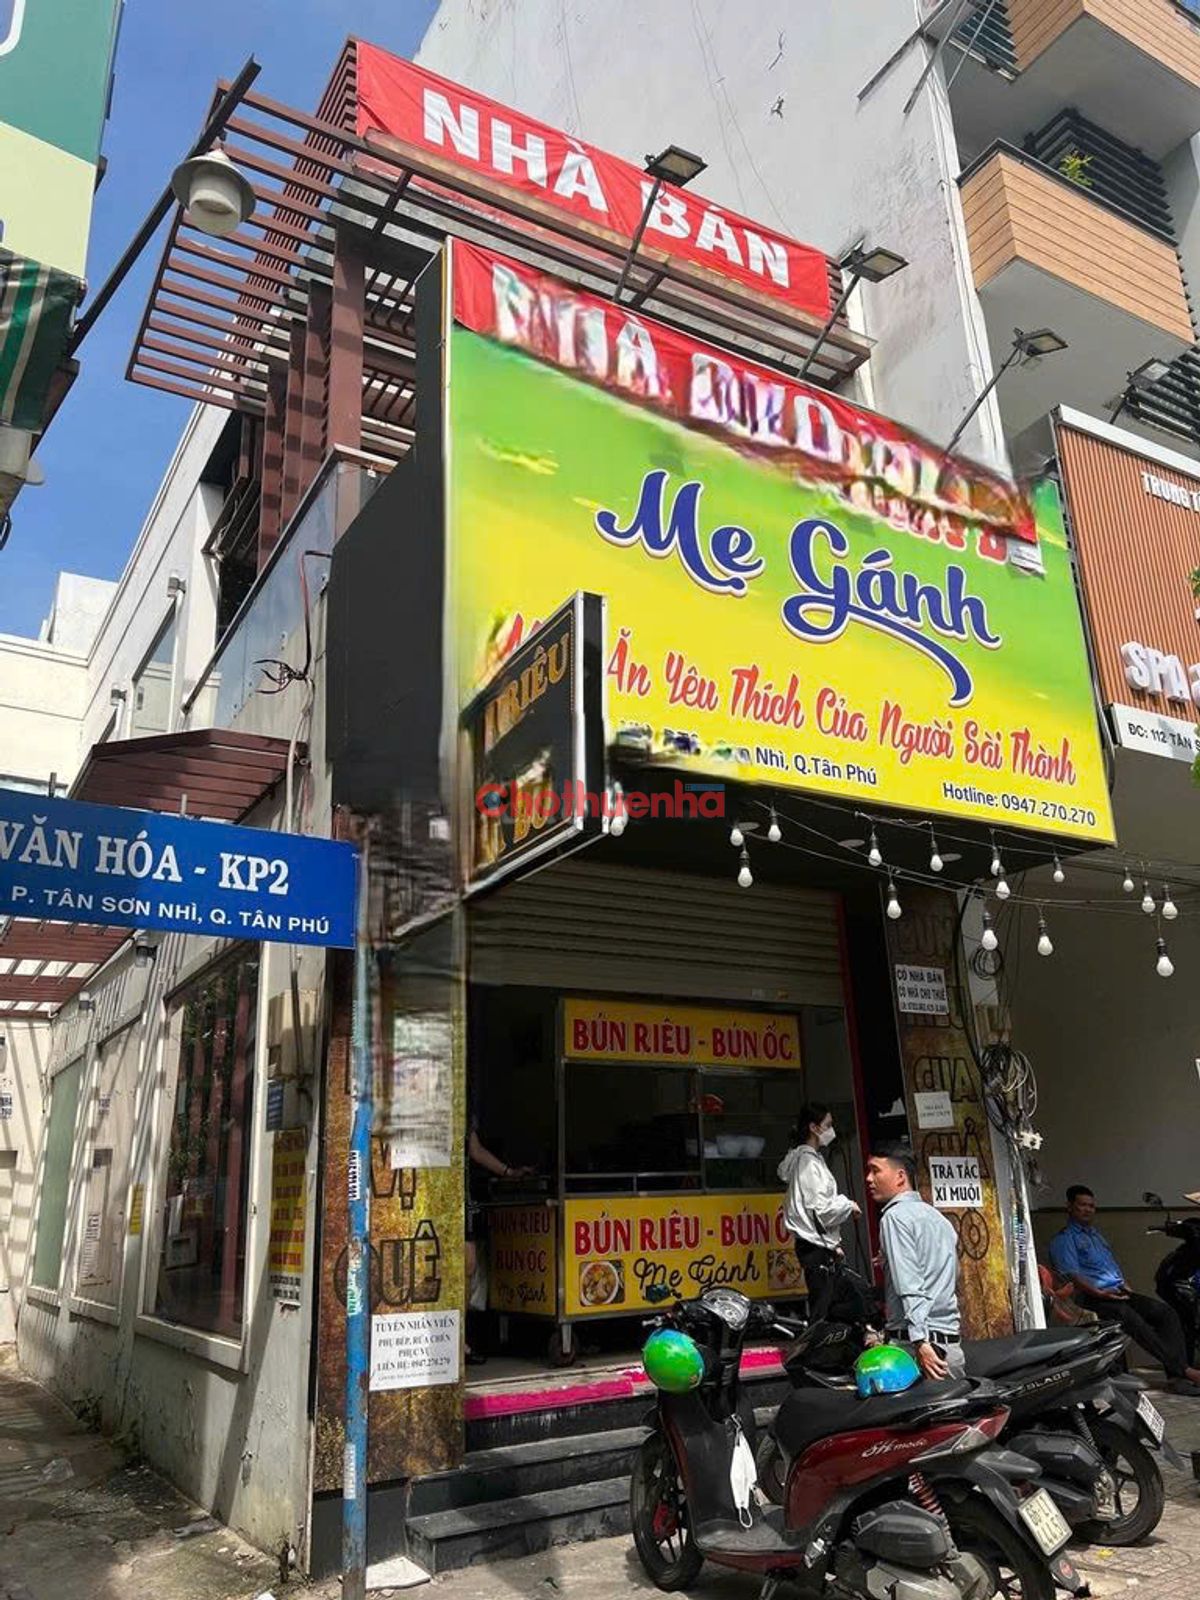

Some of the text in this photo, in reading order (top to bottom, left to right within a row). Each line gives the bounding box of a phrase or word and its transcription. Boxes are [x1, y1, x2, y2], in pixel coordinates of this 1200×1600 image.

[422, 87, 791, 289] NHÀ BÁN
[780, 518, 1001, 706] Gánh
[1120, 640, 1190, 702] SPA
[607, 627, 651, 697] Ăn
[665, 651, 719, 711] Yêu
[731, 663, 804, 729] Thích
[815, 686, 868, 742] Của
[879, 699, 954, 765] Người
[964, 719, 1003, 770] Sài
[1010, 727, 1076, 786] Thành
[1151, 729, 1167, 745] 112
[1170, 732, 1192, 750] TÂN
[755, 745, 877, 785] Nhì, Q.Tân Phú
[943, 782, 1096, 827] Hotline: 0947.270.270
[0, 814, 83, 869] VĂN
[95, 831, 182, 883] HÓA
[218, 851, 289, 896] KP2
[11, 886, 330, 934] P. TÂN SƠN NHÌ, Q. TÂN PHÚ
[573, 1012, 626, 1051] BÚN
[634, 1016, 691, 1055] RIÊU
[711, 1022, 758, 1058] BÚN
[762, 1020, 793, 1060] ỐC
[932, 1161, 954, 1179] TRÀ
[950, 1182, 980, 1204] MUỘI
[574, 1211, 631, 1255] BÚN
[639, 1209, 700, 1251] RIÊU
[720, 1206, 770, 1247] BÚN
